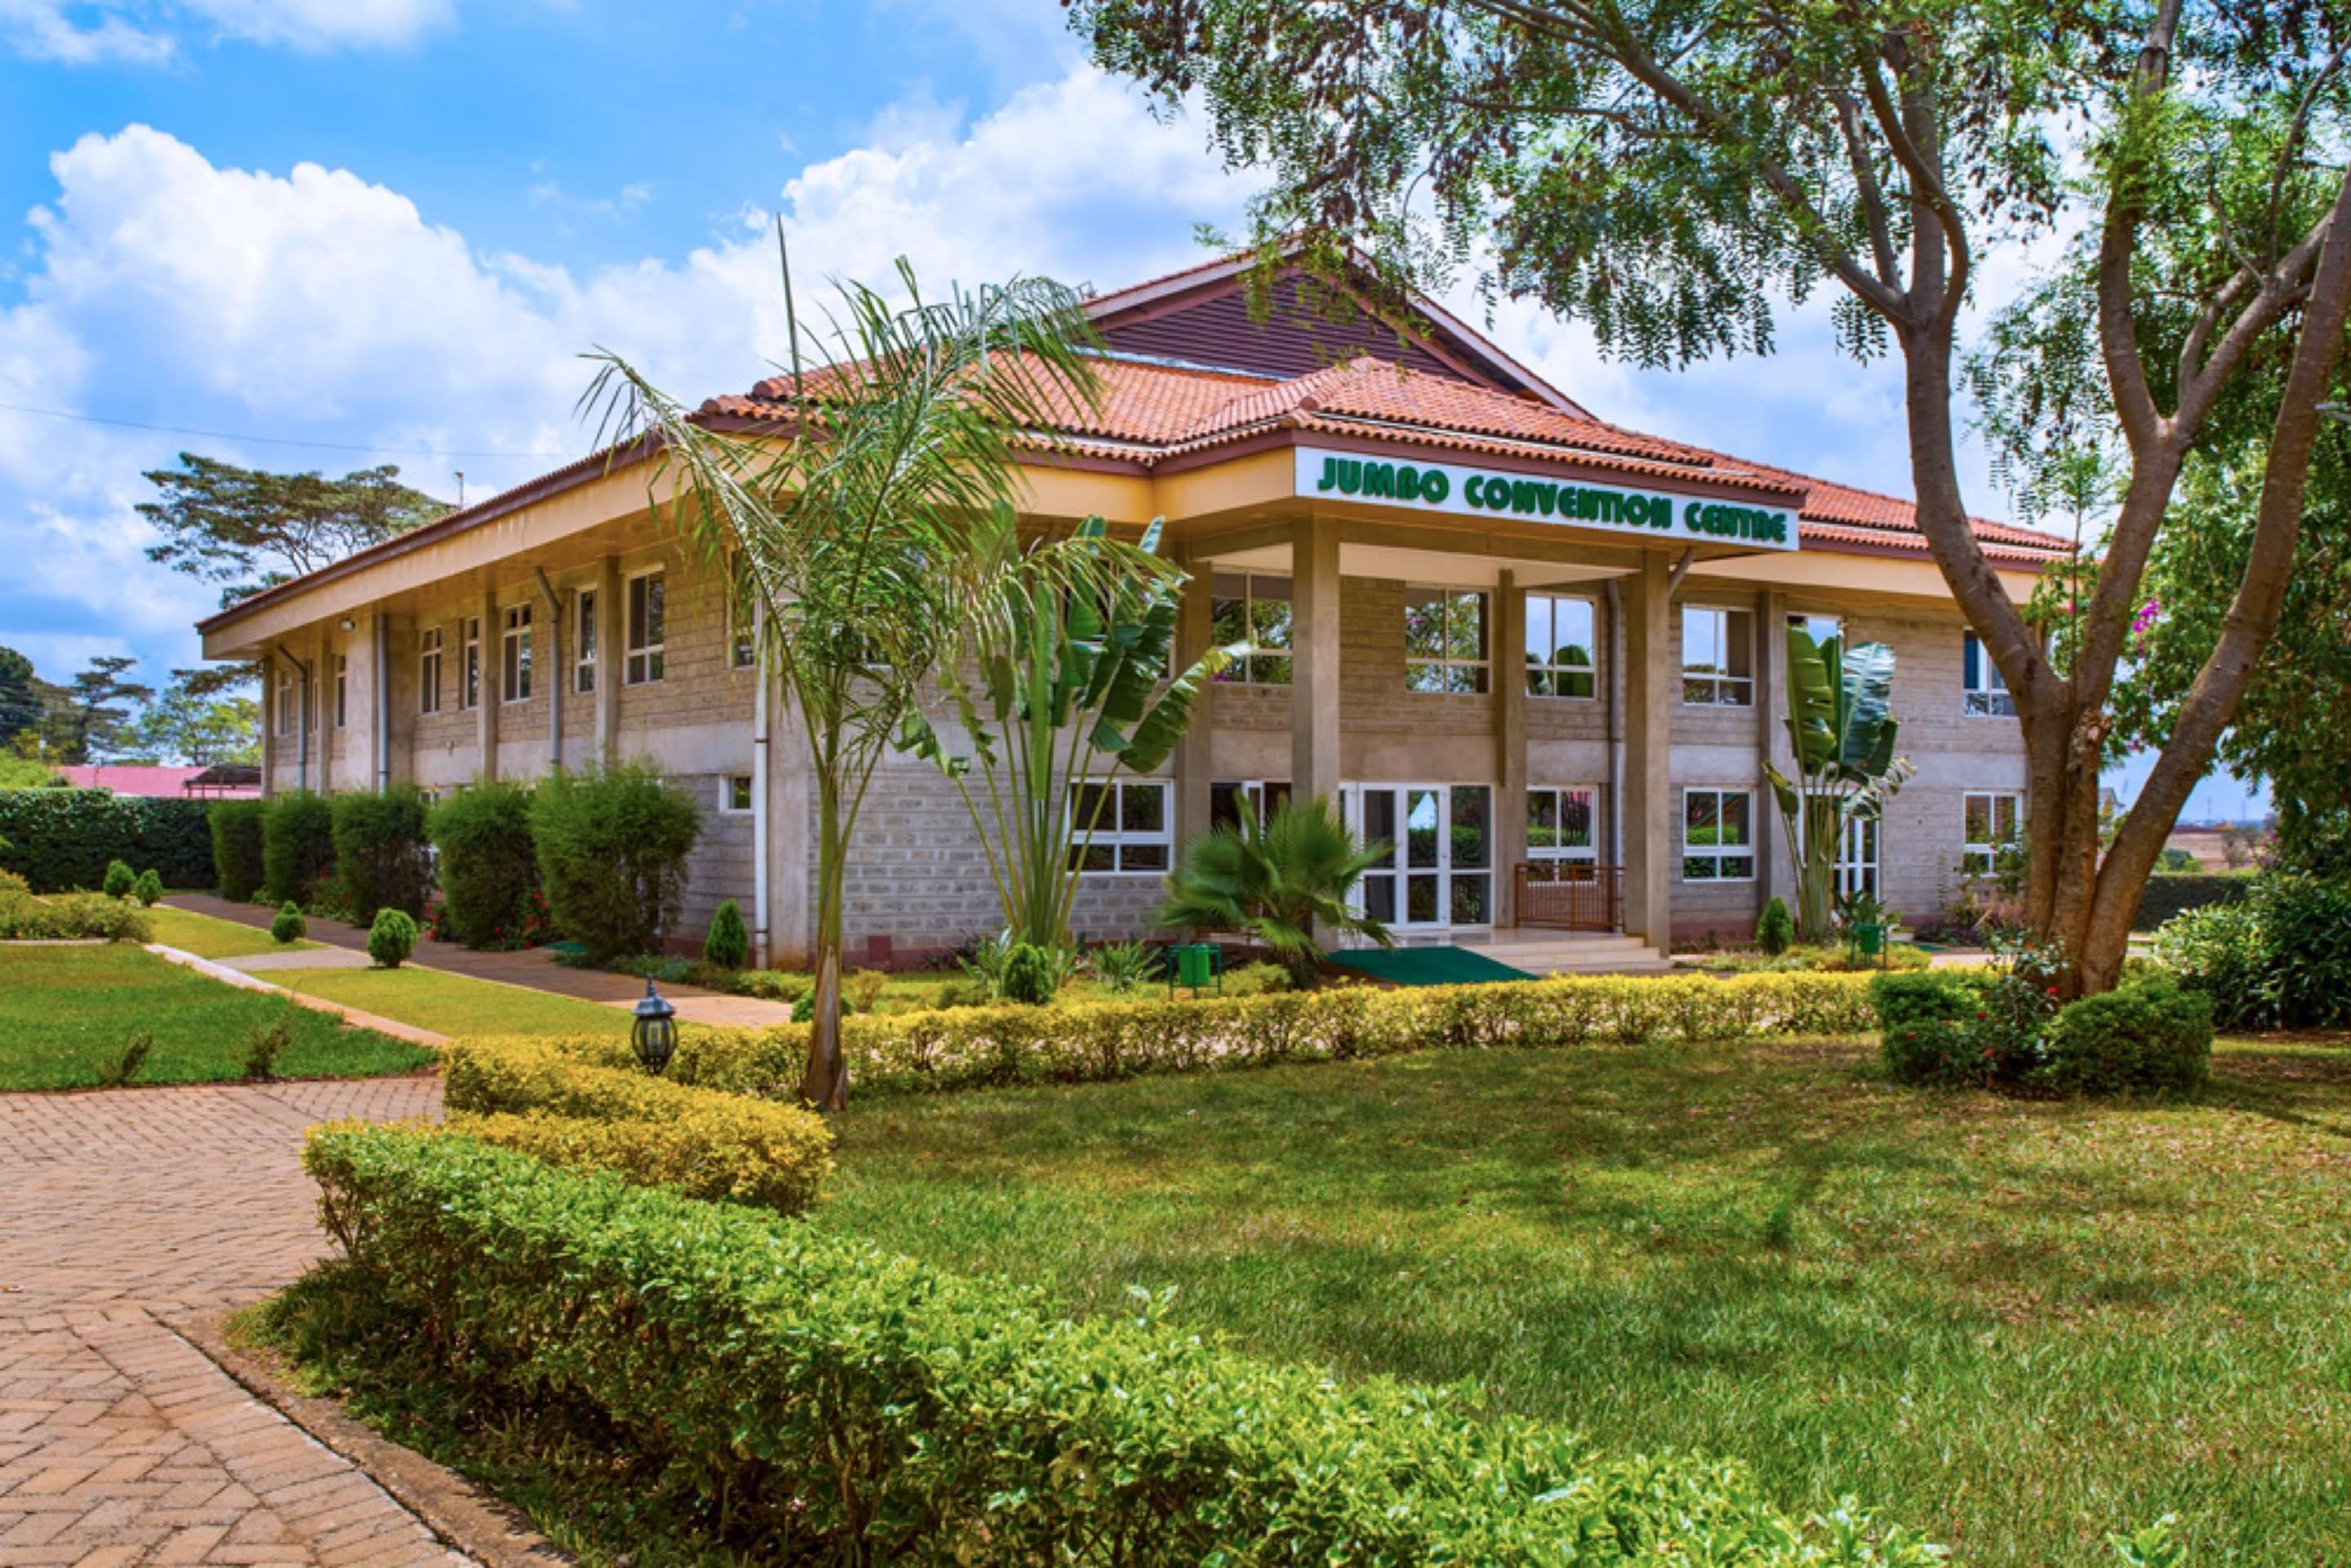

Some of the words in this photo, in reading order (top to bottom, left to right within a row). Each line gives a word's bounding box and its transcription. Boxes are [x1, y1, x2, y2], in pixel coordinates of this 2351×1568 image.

[1317, 457, 1450, 503] JUMBO
[1463, 474, 1672, 529] CONVENTION
[1684, 501, 1788, 542] CENTRE
